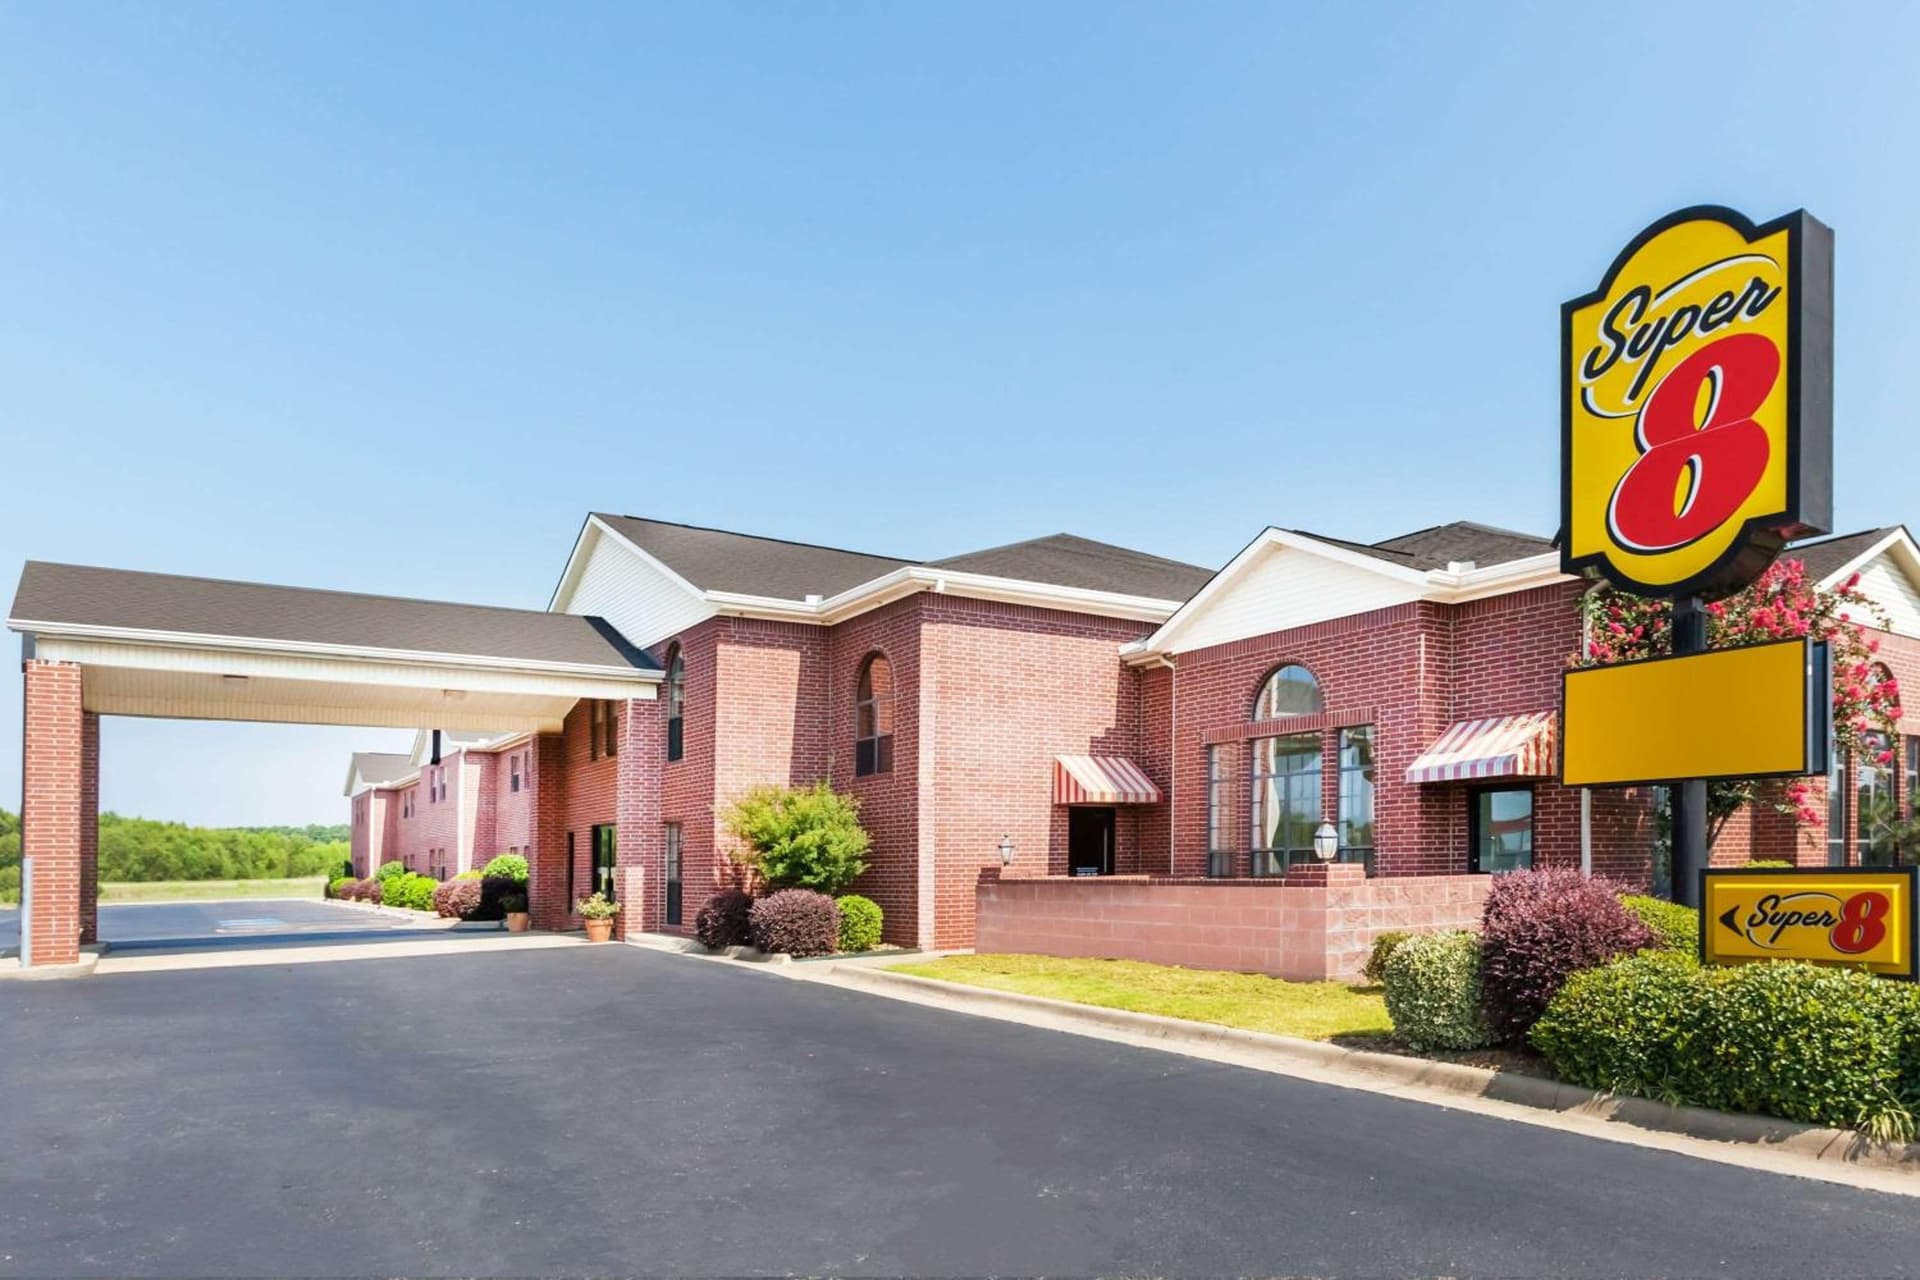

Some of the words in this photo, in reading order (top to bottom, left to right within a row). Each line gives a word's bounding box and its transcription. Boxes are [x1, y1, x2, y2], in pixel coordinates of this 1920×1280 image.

[1580, 276, 1782, 404] Super
[1606, 333, 1781, 555] 8
[1747, 894, 1837, 944] Super
[1829, 892, 1890, 954] 8
